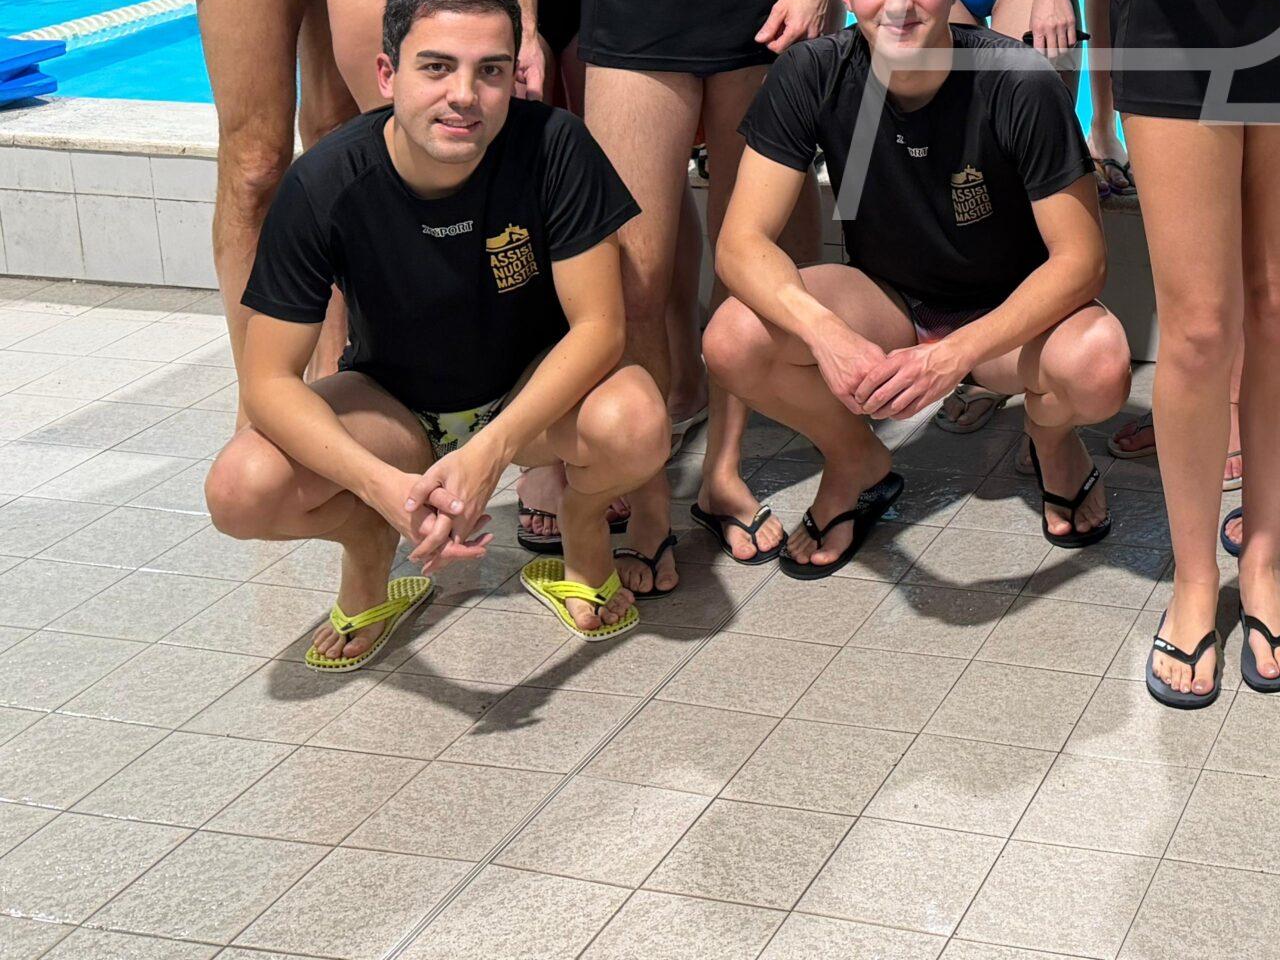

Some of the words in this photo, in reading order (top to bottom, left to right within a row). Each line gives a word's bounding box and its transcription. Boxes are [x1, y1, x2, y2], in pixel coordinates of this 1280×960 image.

[952, 184, 988, 202] ASSISI
[953, 193, 990, 213] NUOTO
[955, 202, 993, 222] MASTER
[490, 243, 533, 268] ASSISI
[493, 252, 536, 279] NUOTO
[496, 260, 538, 289] MASTER
